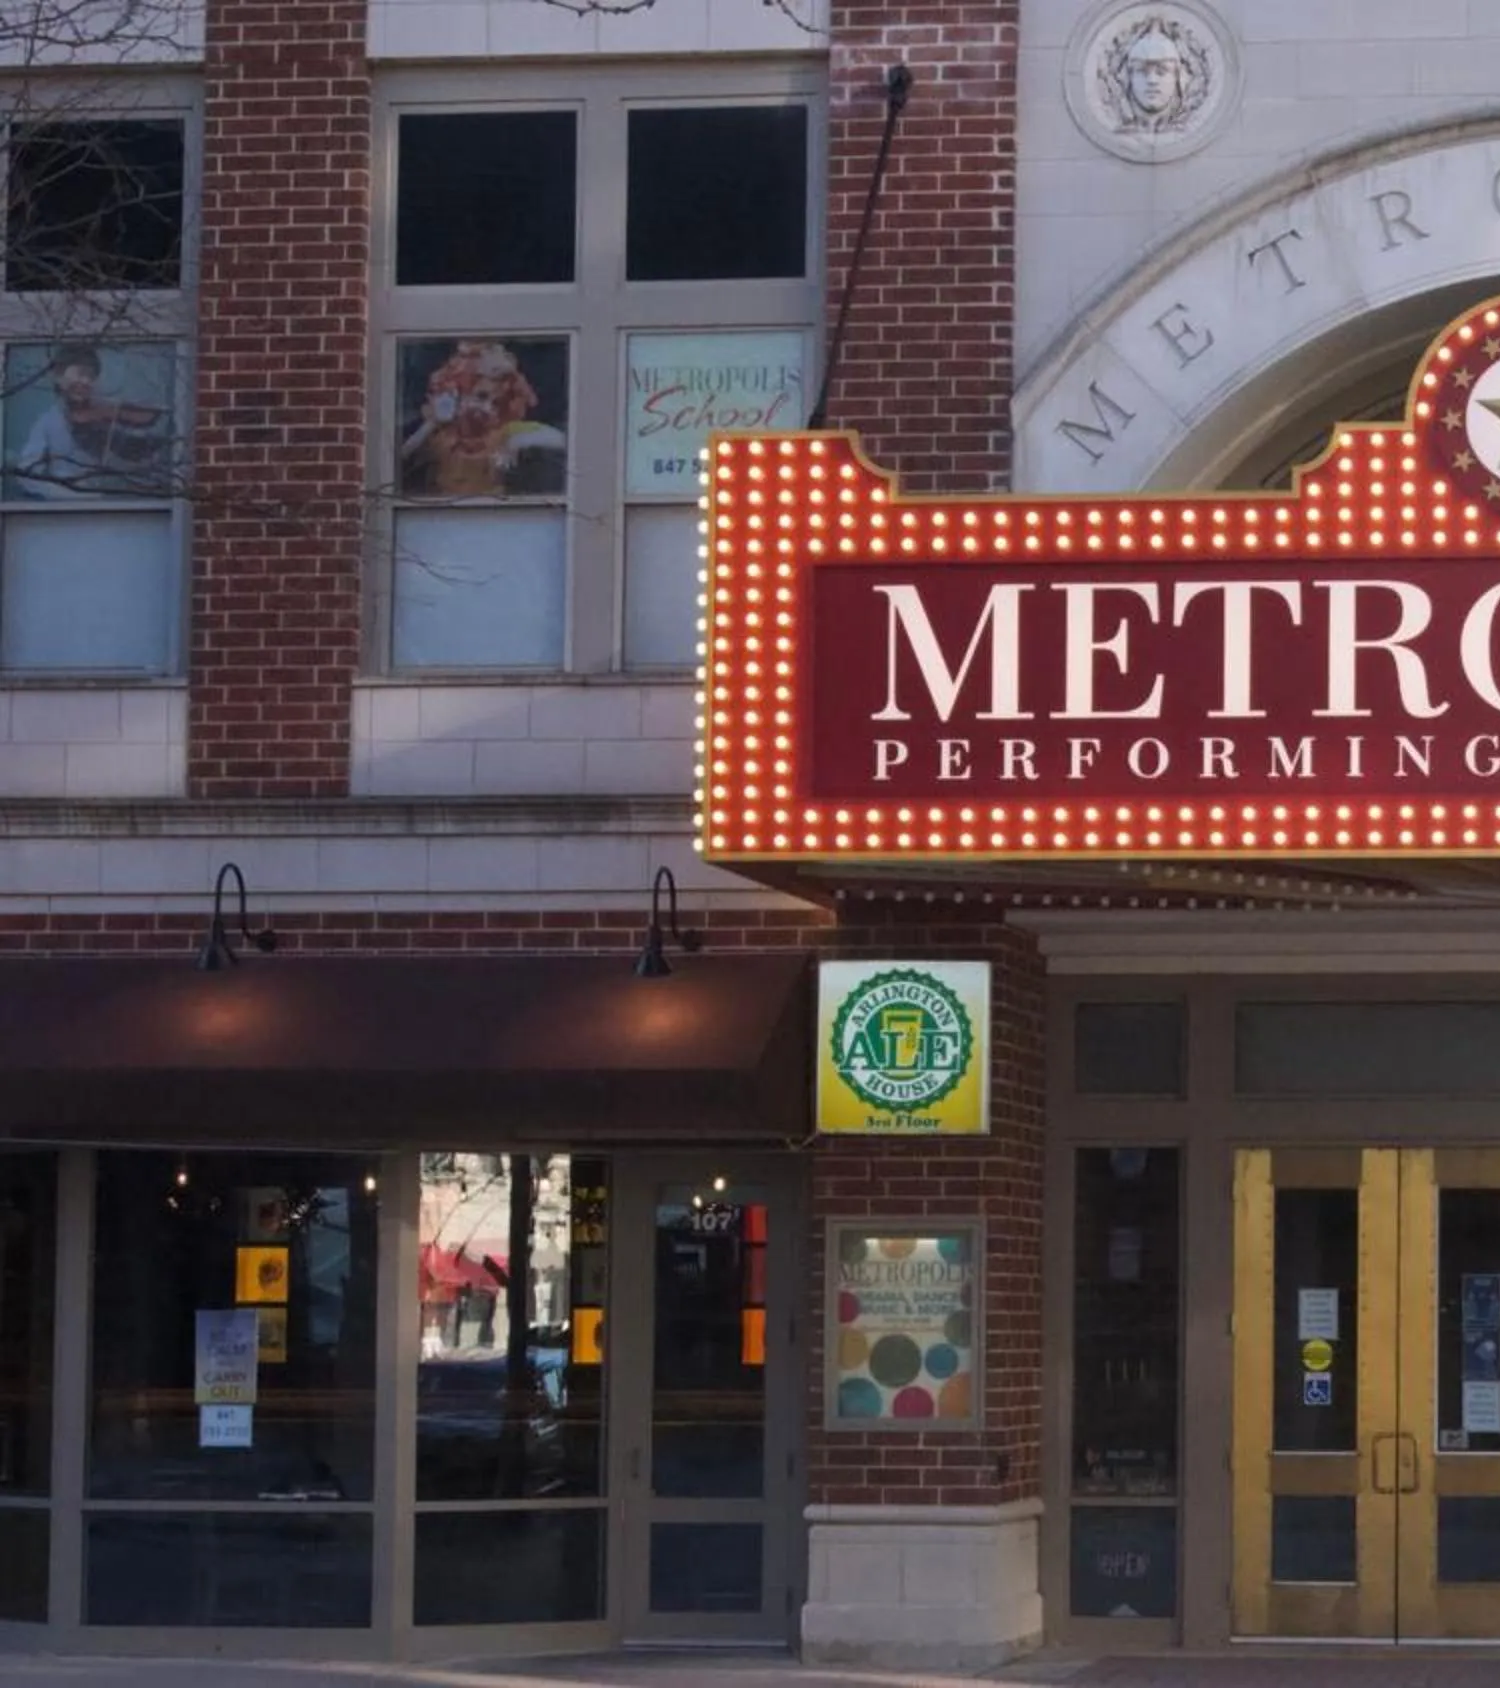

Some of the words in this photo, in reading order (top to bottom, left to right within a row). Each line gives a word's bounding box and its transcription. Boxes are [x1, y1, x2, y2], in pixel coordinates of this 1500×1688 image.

[630, 365, 802, 393] METROPOLIS
[637, 385, 791, 438] School
[652, 458, 687, 475] 847
[851, 983, 955, 1030] ARLINGTON
[840, 1030, 959, 1070] ALE
[865, 1073, 939, 1099] HOUSE
[895, 1113, 942, 1129] Floor
[691, 1211, 732, 1231] 107
[837, 1260, 975, 1284] METROPOLIS
[203, 1371, 248, 1385] CARRY
[210, 1385, 241, 1398] OUT
